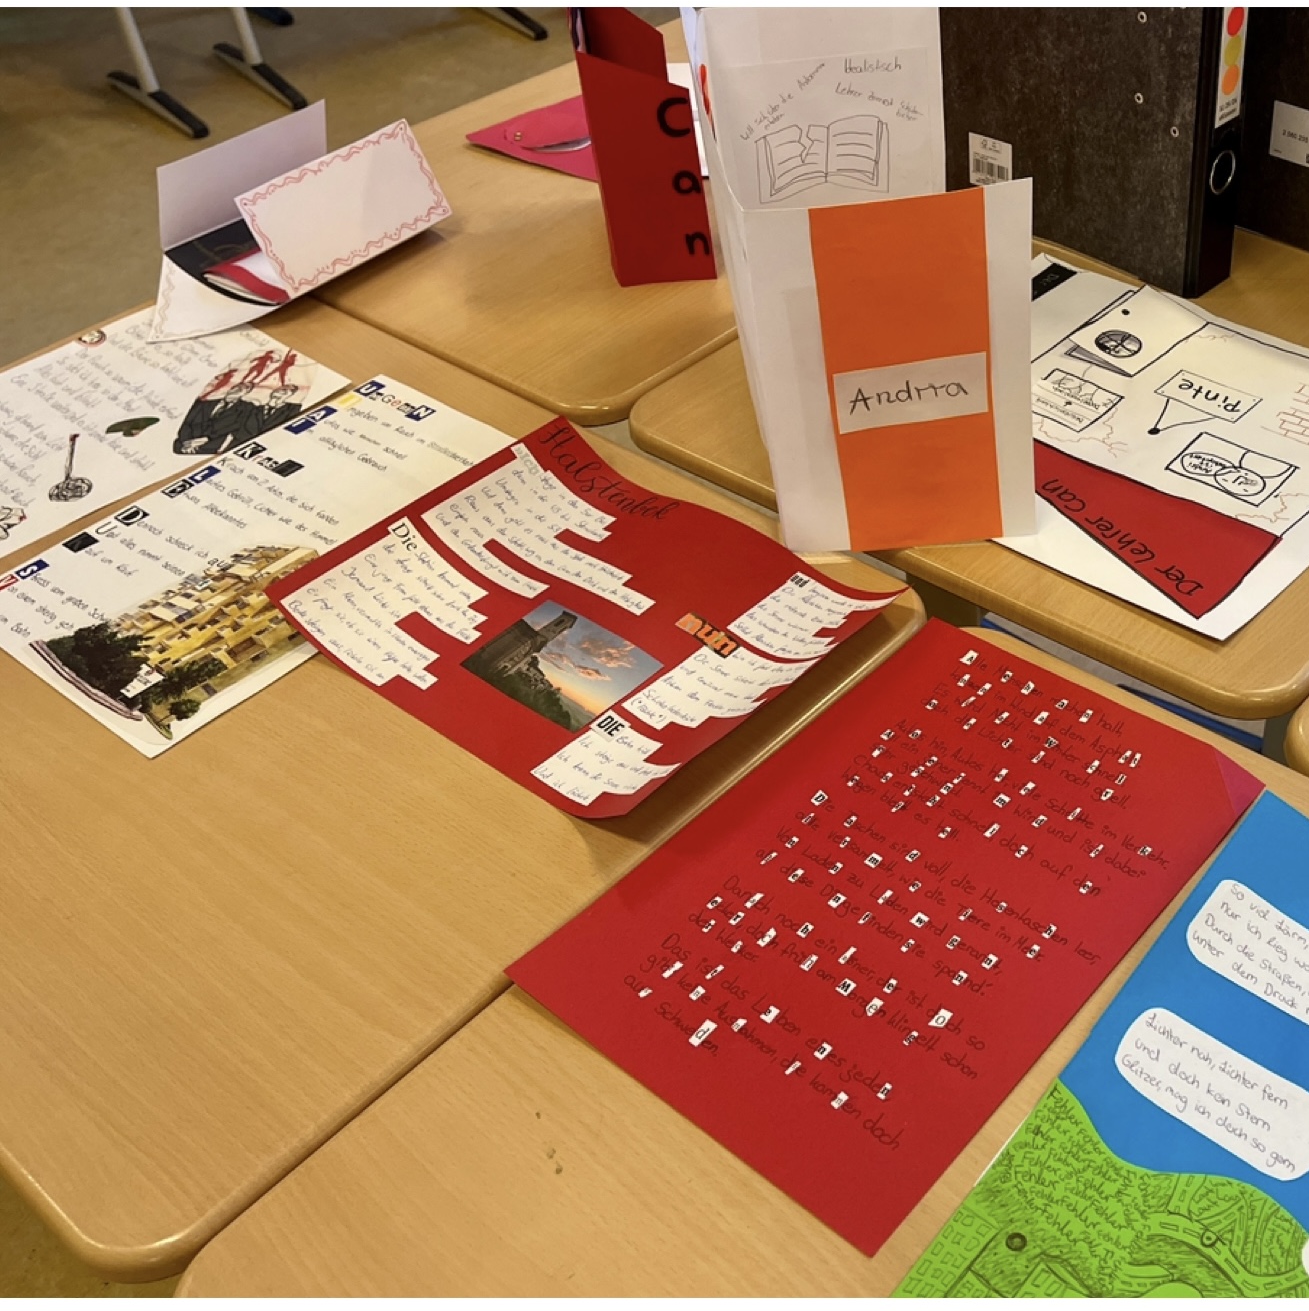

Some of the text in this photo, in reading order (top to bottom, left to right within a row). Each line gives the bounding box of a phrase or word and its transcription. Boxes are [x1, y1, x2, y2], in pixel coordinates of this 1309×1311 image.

[1177, 378, 1241, 414] Pinte
[1040, 479, 1085, 516] Can
[392, 522, 418, 554] Die
[1156, 567, 1203, 597] Der
[677, 612, 739, 655] nun
[595, 715, 625, 739] DIE
